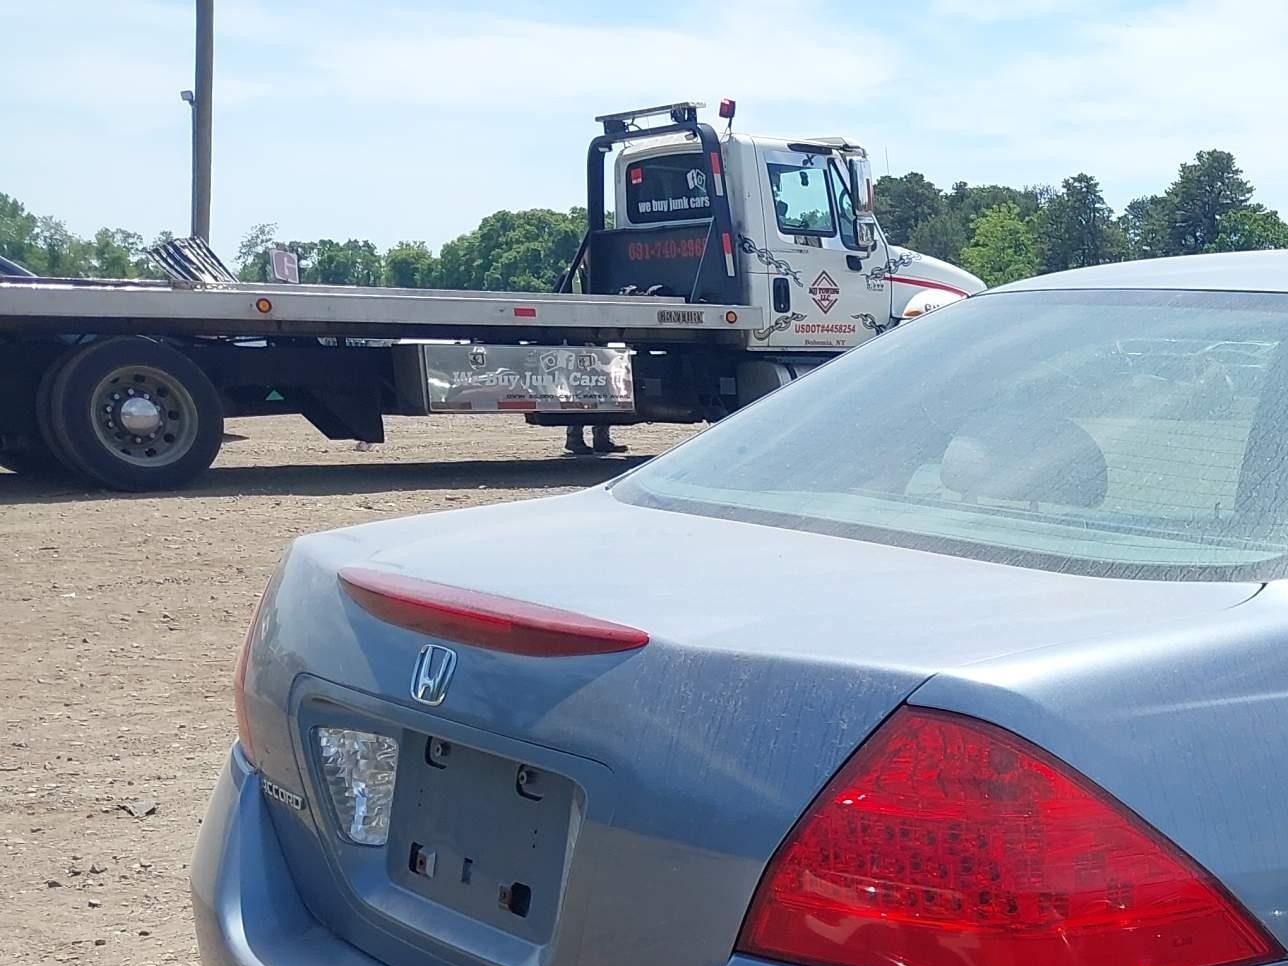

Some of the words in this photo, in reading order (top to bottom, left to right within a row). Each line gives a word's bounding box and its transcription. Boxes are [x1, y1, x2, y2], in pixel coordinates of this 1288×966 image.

[638, 201, 651, 213] we
[652, 199, 668, 212] buy
[669, 196, 689, 211] junk
[690, 196, 710, 208] cars
[657, 310, 704, 323] CENTURY
[794, 324, 856, 334] USDOT#4458254
[485, 371, 520, 390] Buy
[569, 371, 607, 386] Cars
